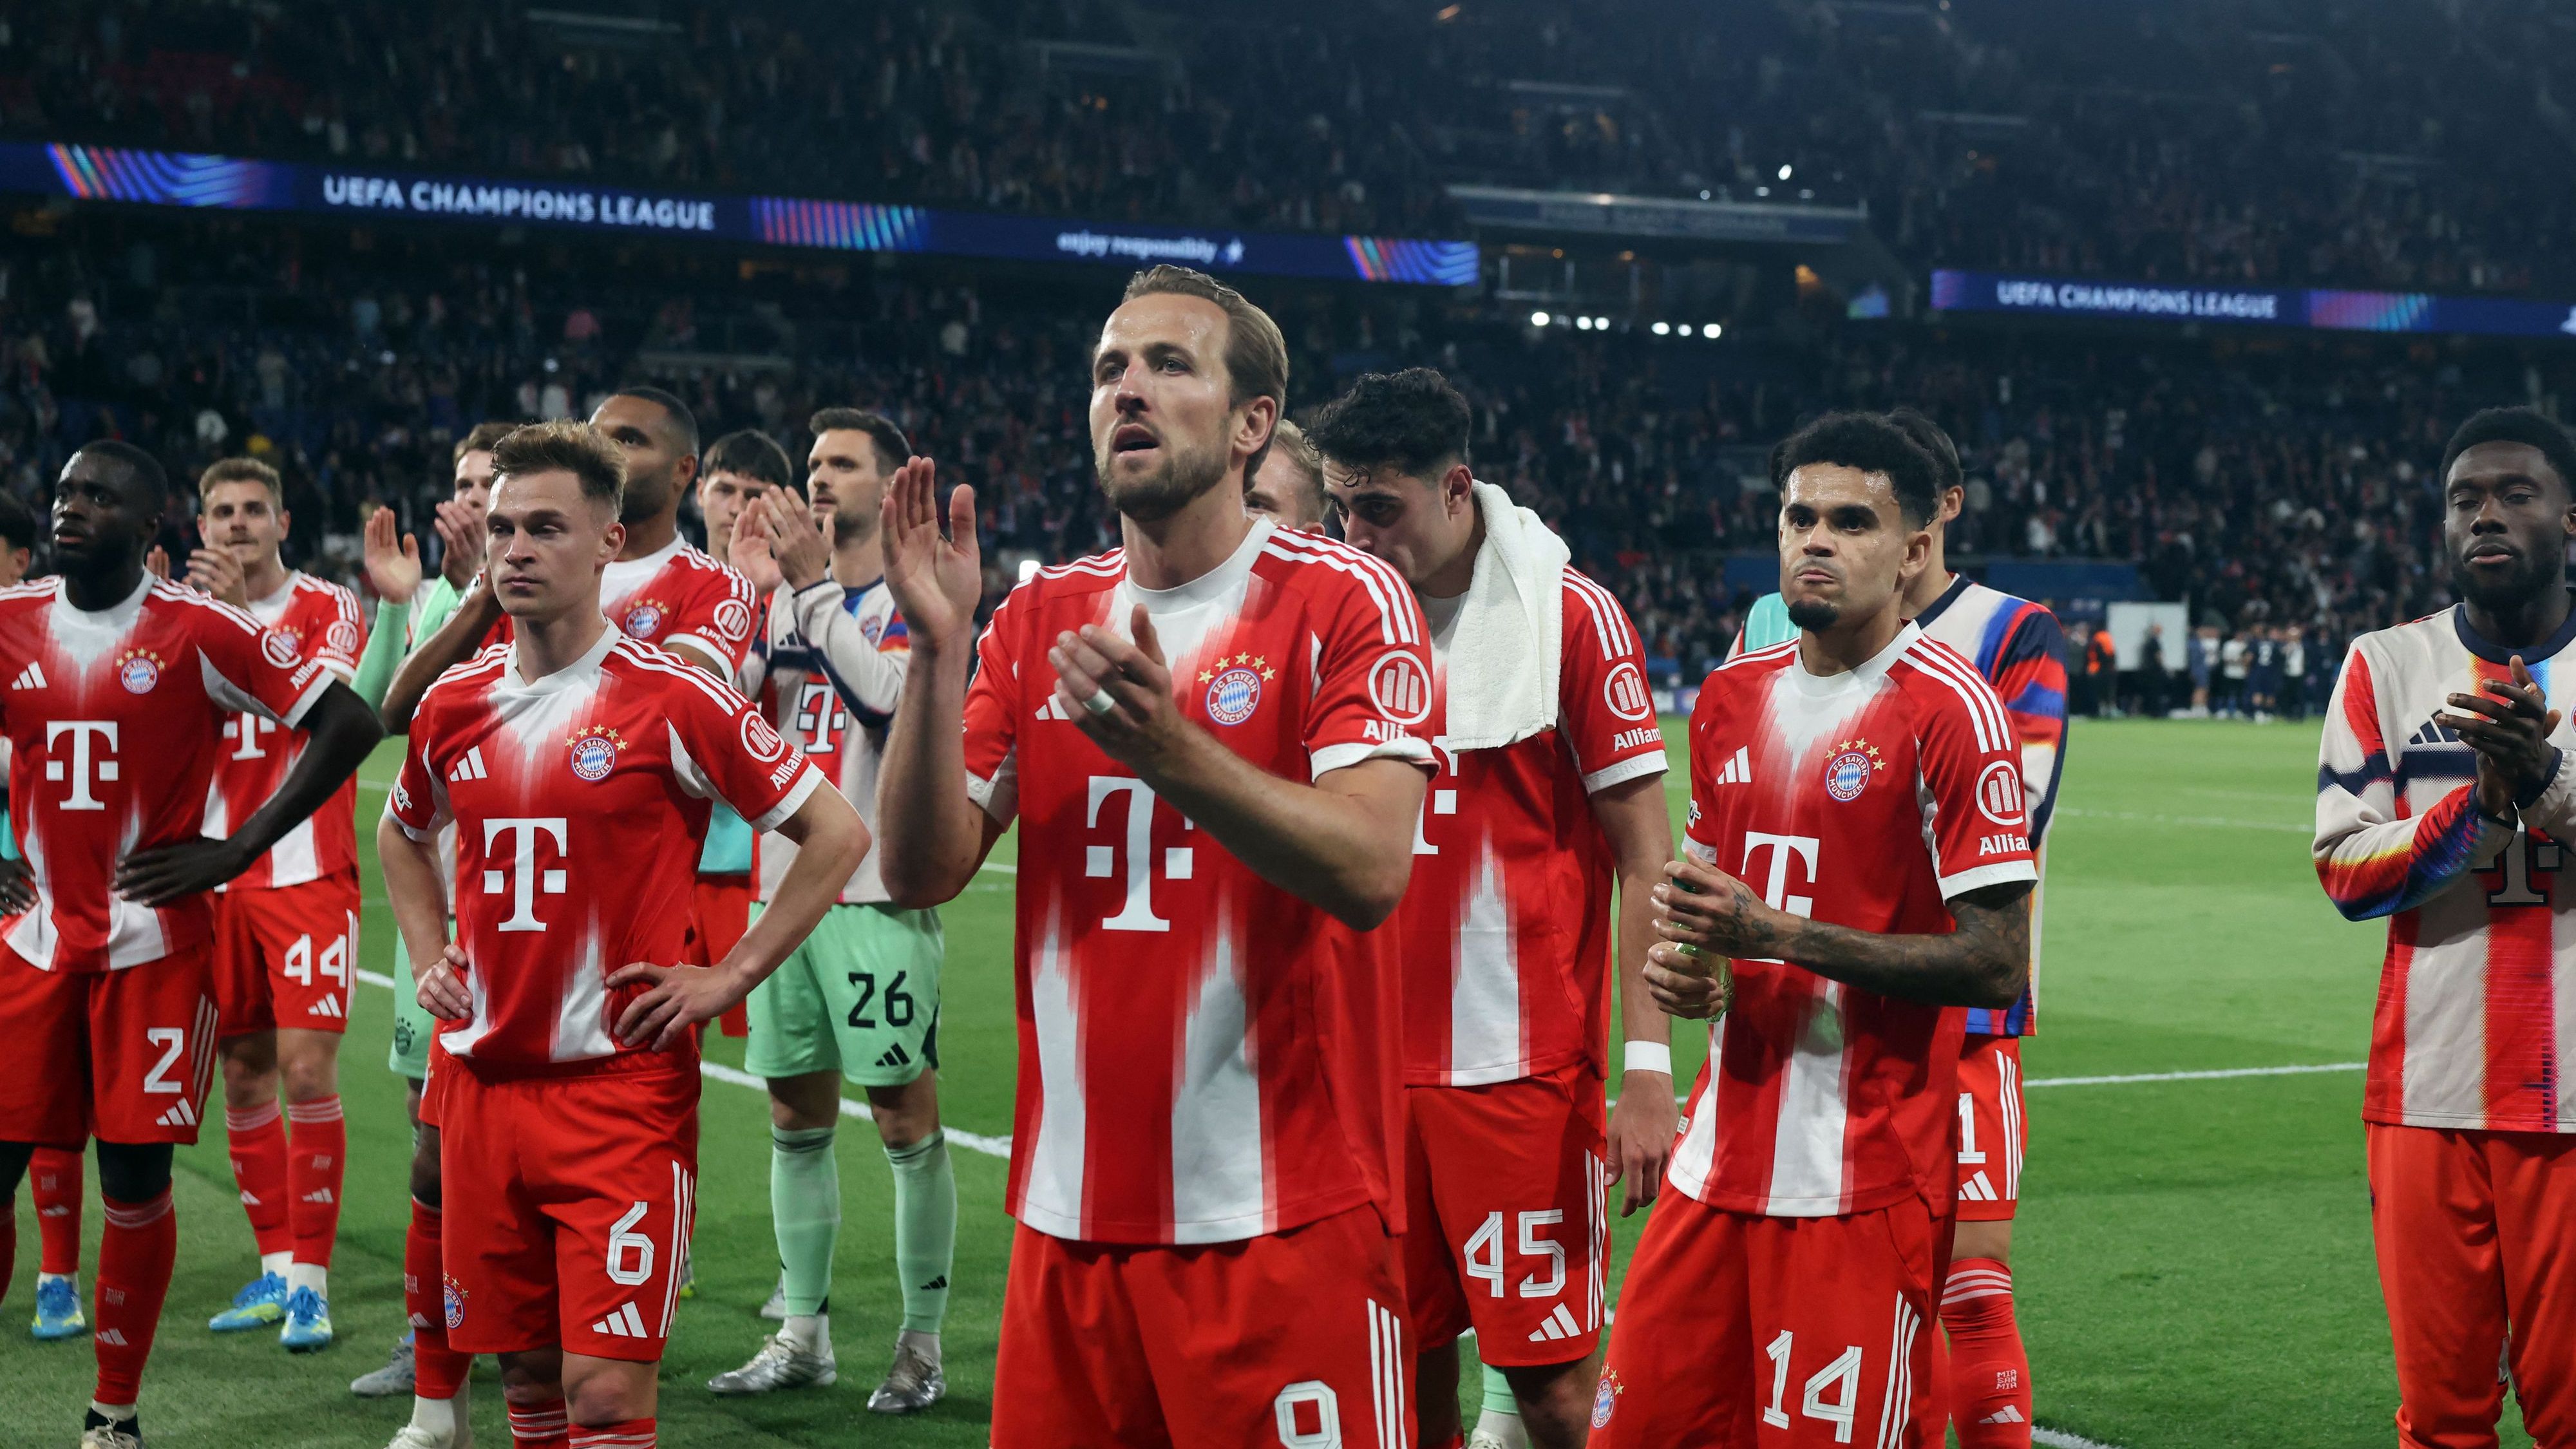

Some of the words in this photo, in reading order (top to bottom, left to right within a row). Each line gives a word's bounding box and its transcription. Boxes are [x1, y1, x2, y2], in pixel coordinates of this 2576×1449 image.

[324, 175, 404, 208] UEFA
[410, 181, 595, 222] CHAMPIONS
[600, 194, 715, 231] LEAGUE
[1997, 281, 2056, 307] UEFA
[2060, 283, 2191, 315] CHAMPIONS
[2192, 292, 2277, 318] LEAGUE
[1213, 681, 1226, 694] FC
[1226, 673, 1257, 693] BAYERN
[576, 745, 585, 756] FC
[586, 740, 612, 758] BAYERN
[1362, 719, 1411, 741] Alli
[1613, 727, 1662, 752] Allian
[46, 721, 118, 810] T
[770, 748, 804, 791] Allian
[1833, 760, 1843, 772] FC
[1845, 756, 1867, 777] BAYERN
[1086, 775, 1193, 932] T
[1979, 833, 2031, 857] Allia
[484, 818, 567, 932] T
[284, 934, 347, 988] 44
[848, 971, 914, 1027] 26
[147, 1027, 184, 1094] 2
[607, 1201, 654, 1285] 6
[1463, 1209, 1566, 1299] 45
[1763, 1330, 1862, 1443] 14
[1997, 1369, 2017, 1378] MIA
[1997, 1375, 2017, 1384] SAN
